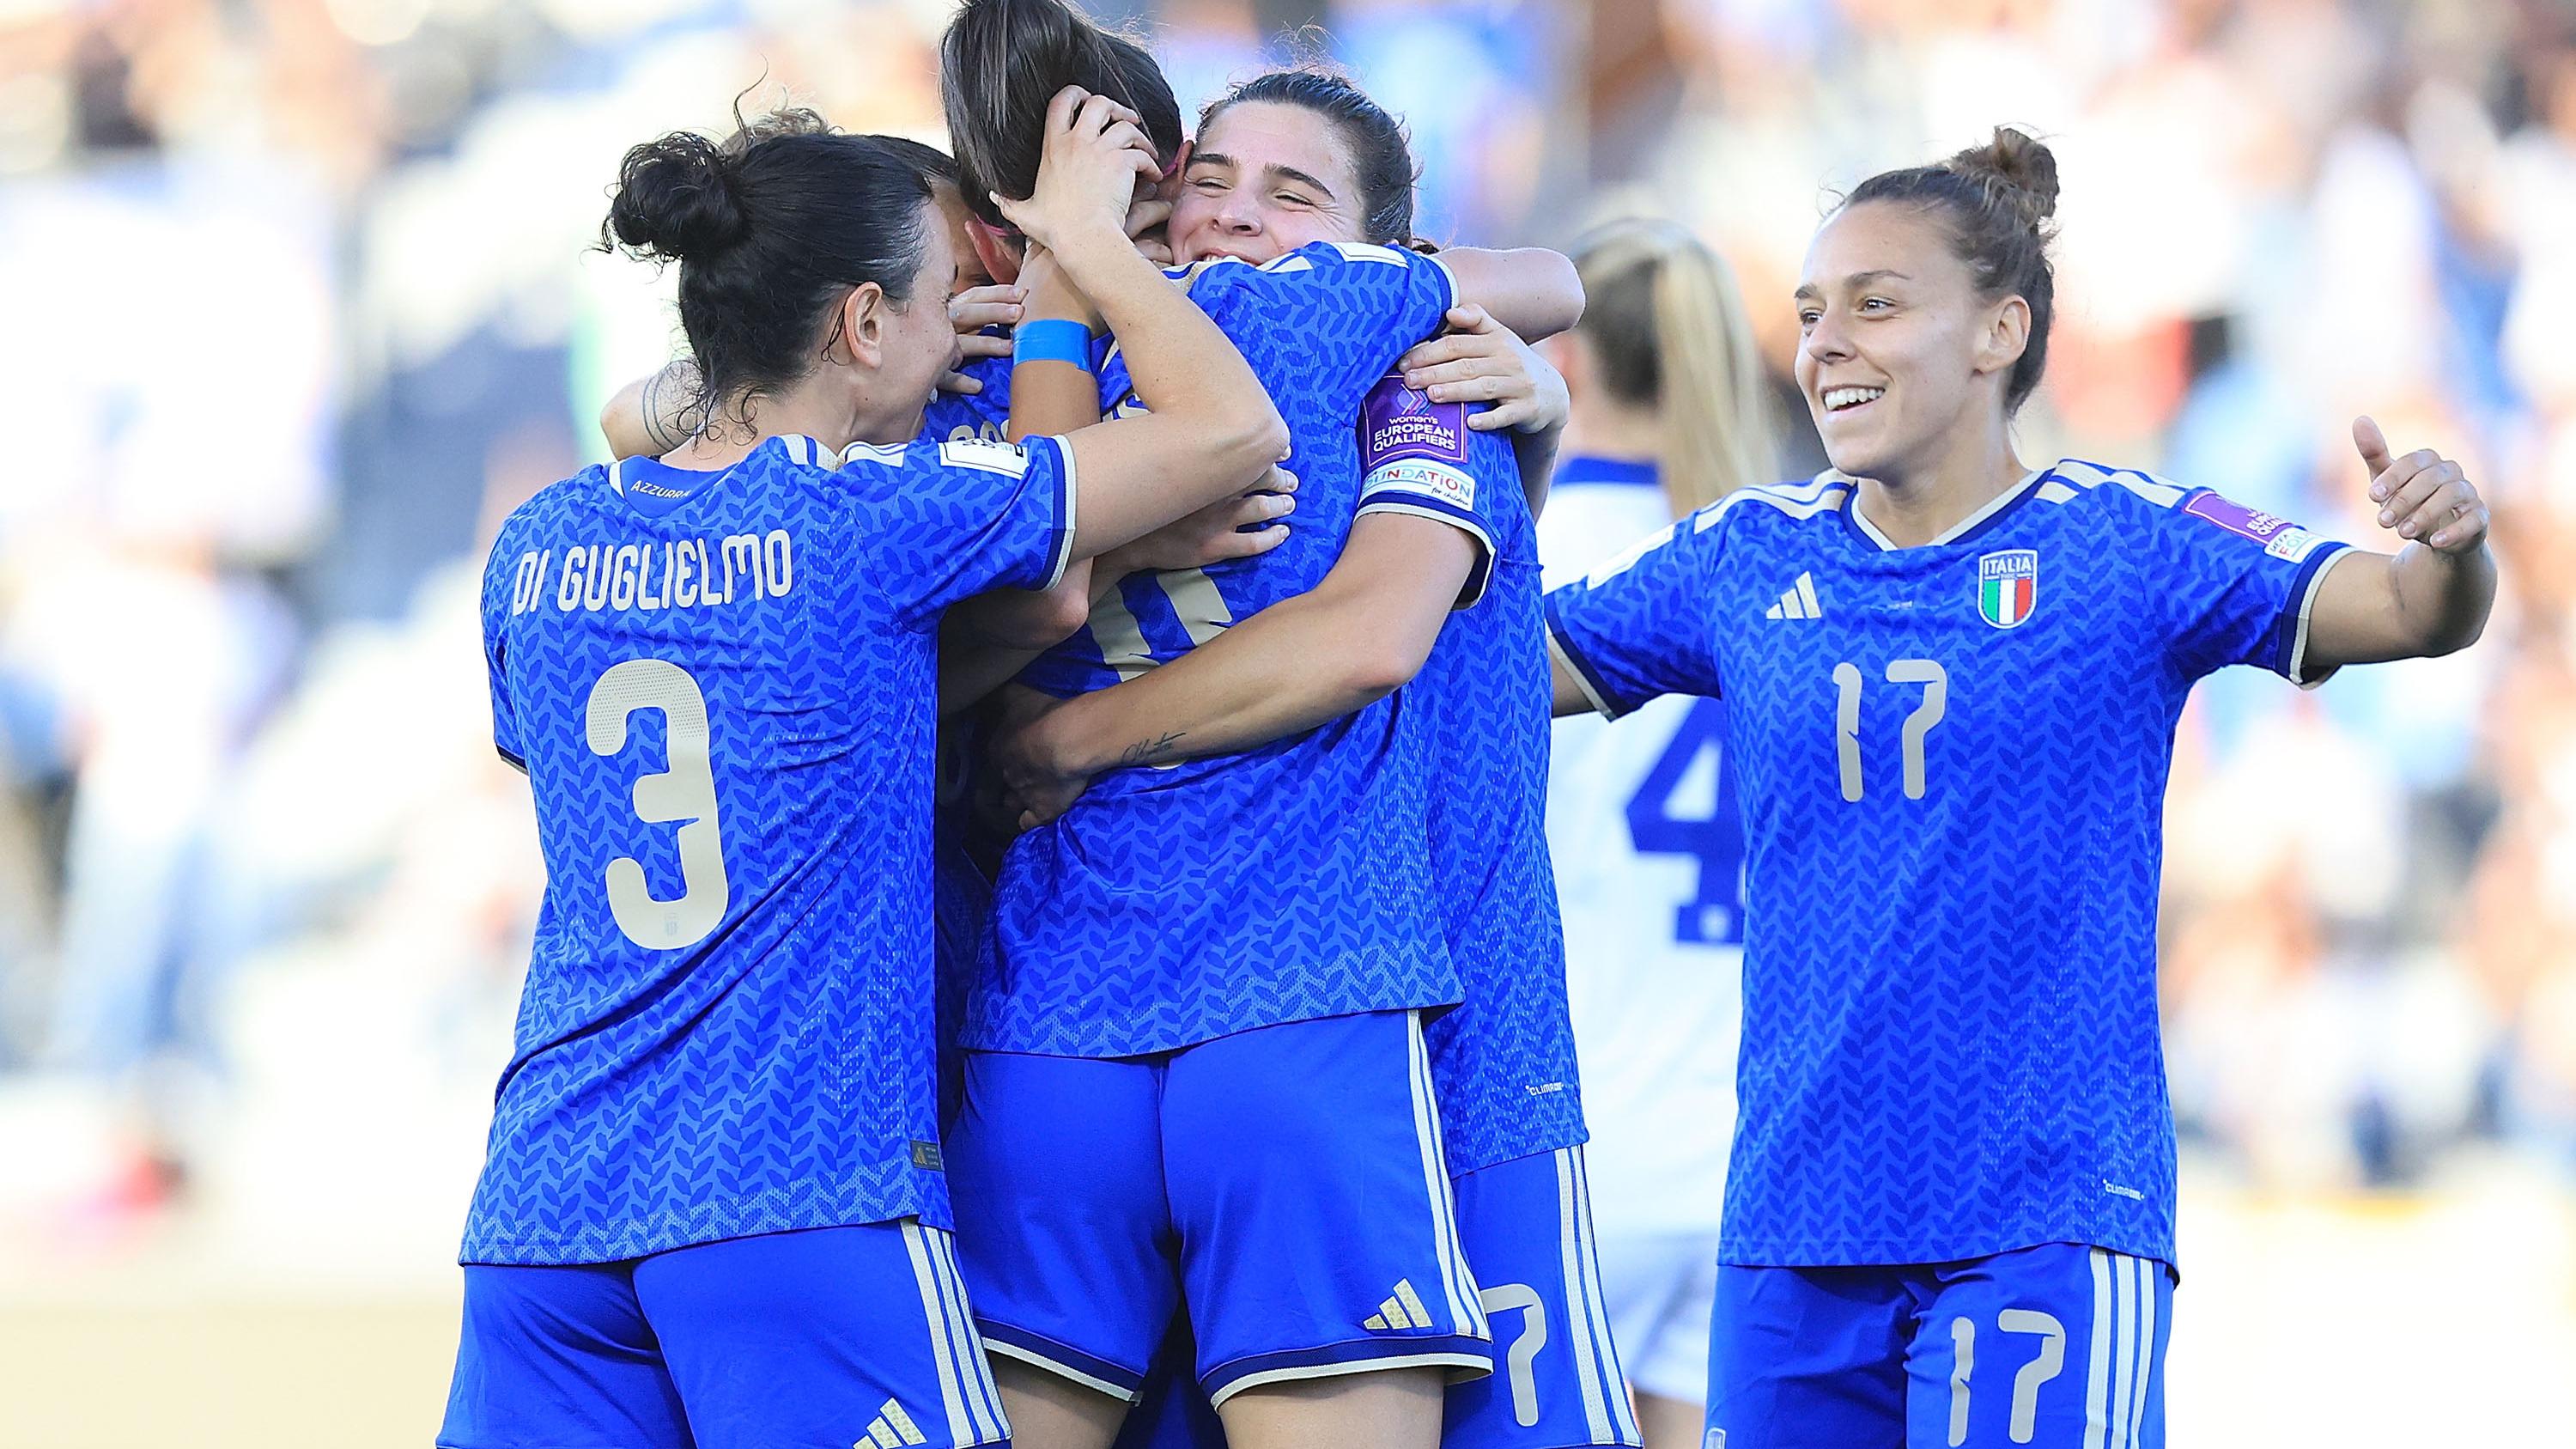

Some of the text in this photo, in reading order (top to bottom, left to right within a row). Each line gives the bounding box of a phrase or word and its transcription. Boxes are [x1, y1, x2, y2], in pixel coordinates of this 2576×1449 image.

[1373, 433, 1456, 452] QUALIFIERS
[1374, 423, 1455, 441] EUROPEAN
[1388, 413, 1438, 425] women's
[1363, 469, 1471, 498] OUNDATION
[512, 528, 793, 617] DI GUGLIELMO
[1984, 556, 2032, 576] ITALIA
[1832, 659, 1948, 803] 17
[586, 659, 729, 950] 3
[1625, 696, 1747, 945] 4
[1947, 1308, 2067, 1448] 17
